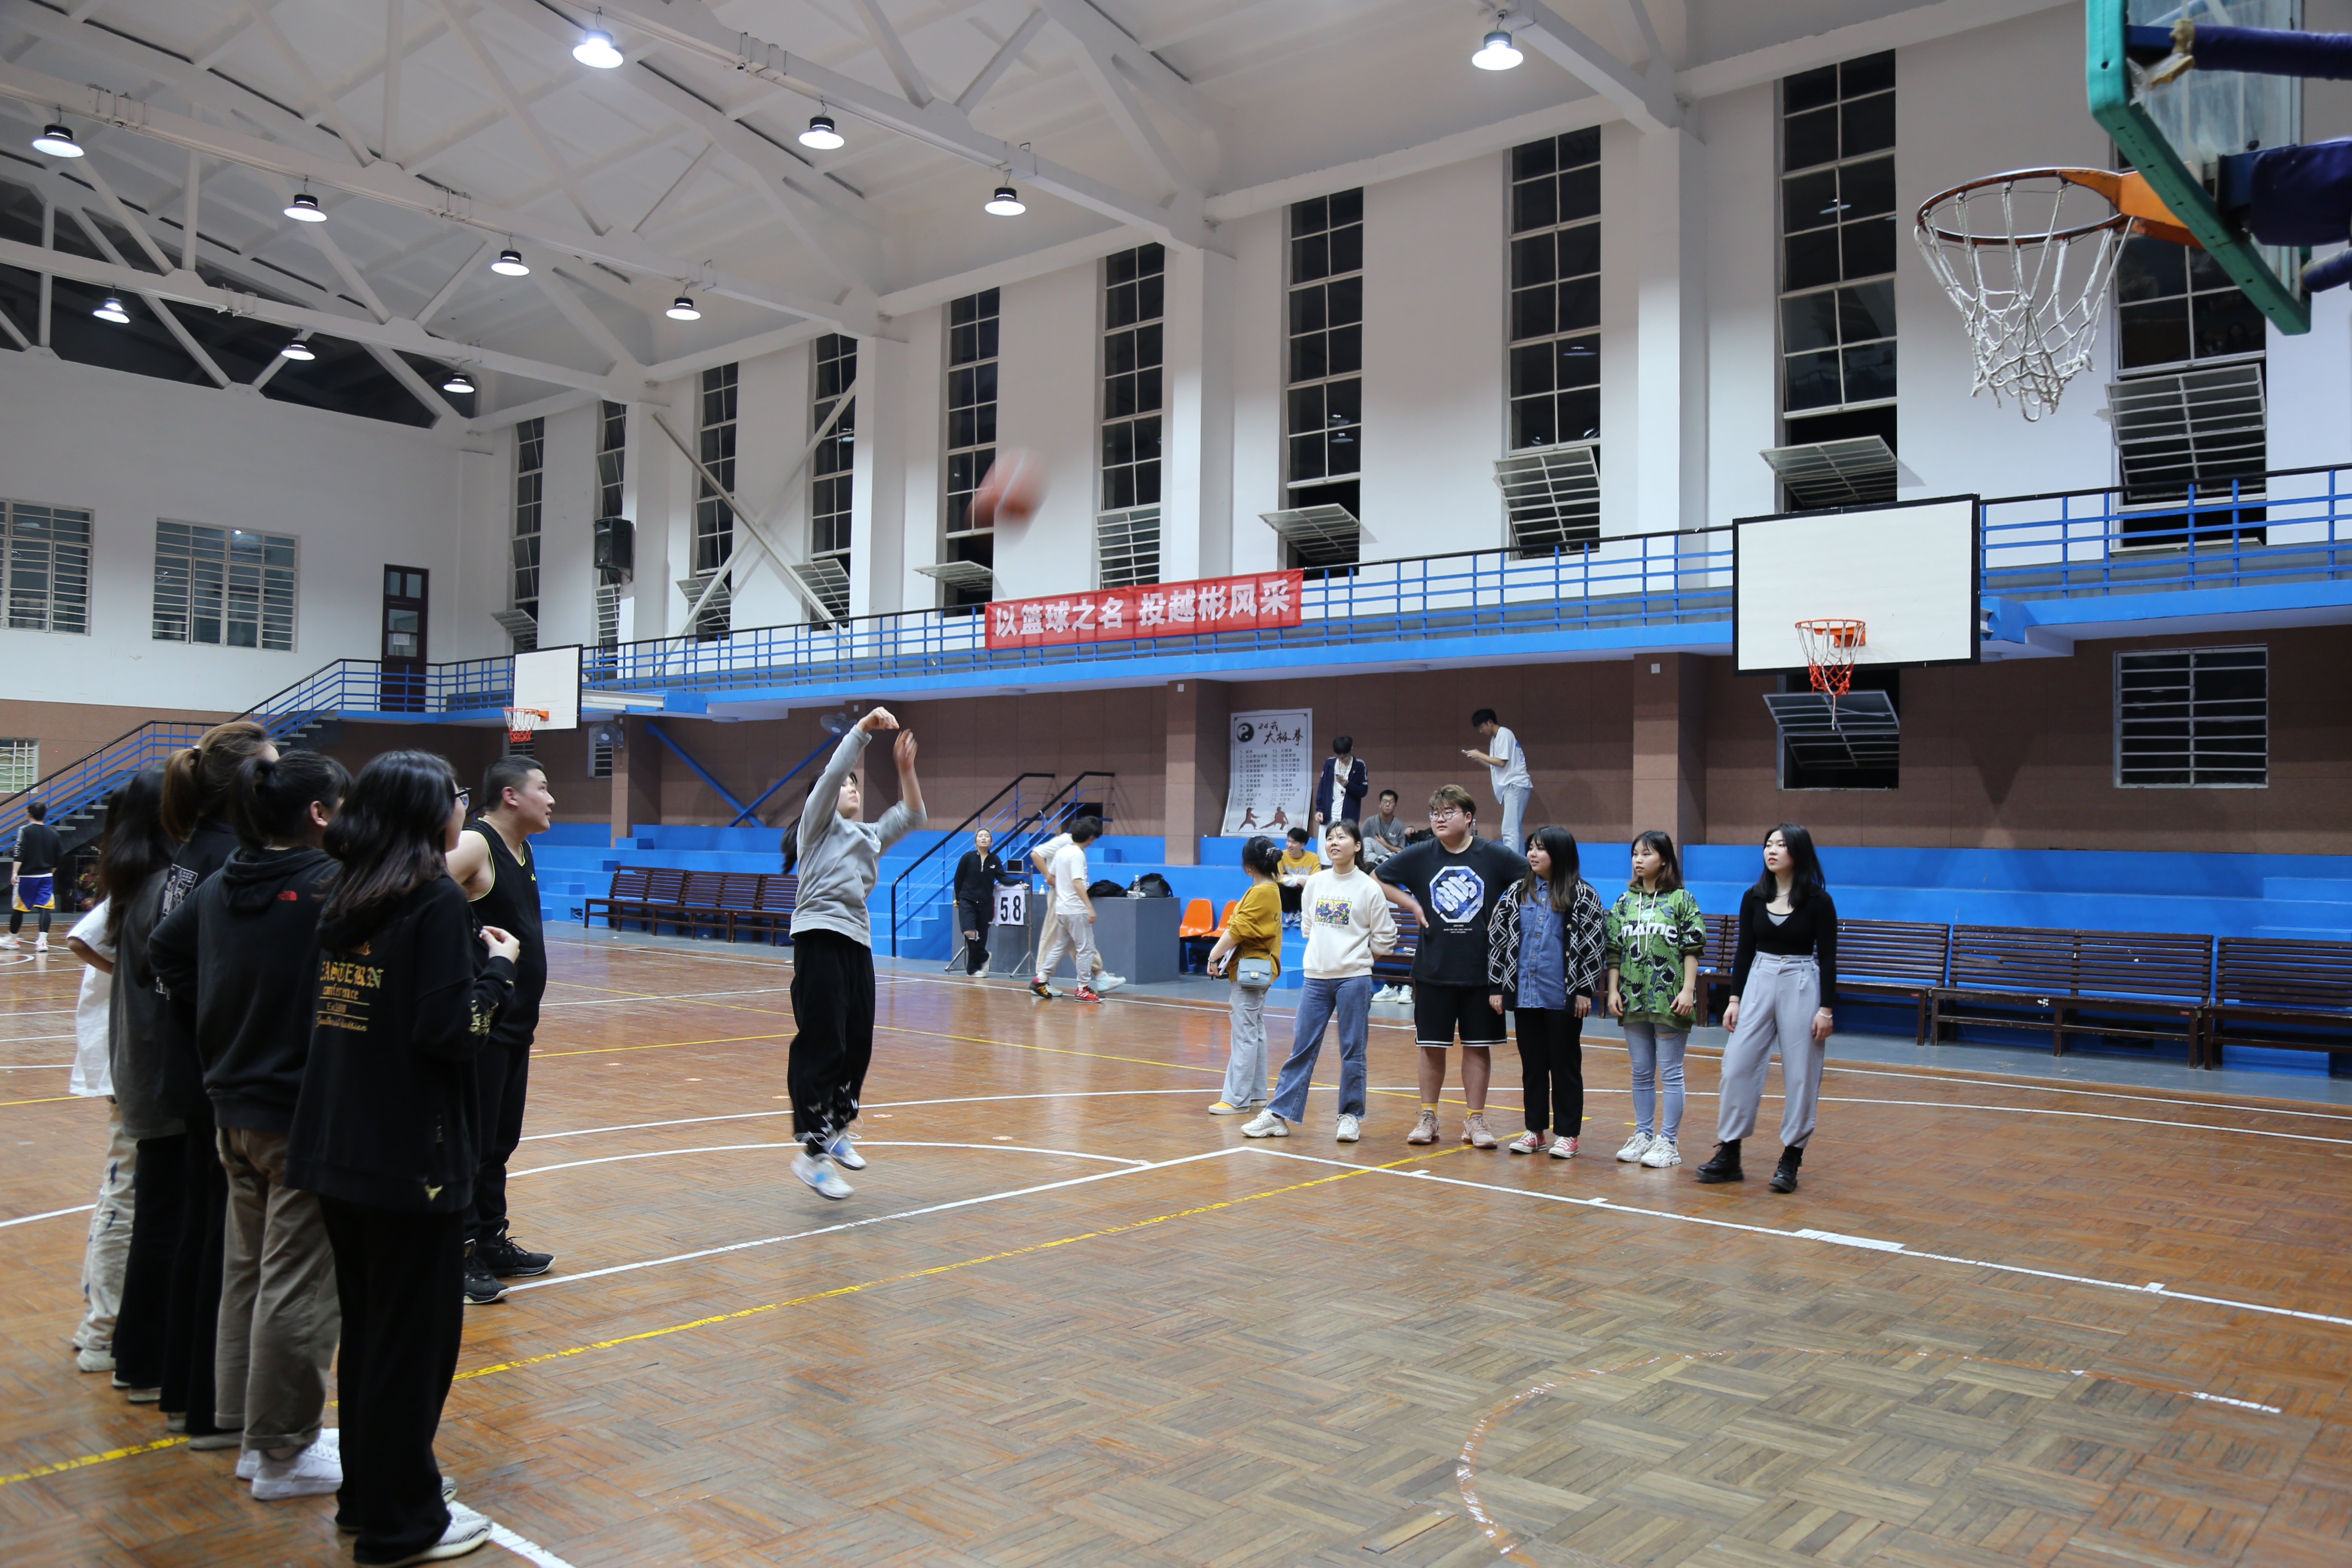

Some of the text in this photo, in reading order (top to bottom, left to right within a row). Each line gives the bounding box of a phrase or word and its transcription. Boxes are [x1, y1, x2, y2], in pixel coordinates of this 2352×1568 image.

[995, 579, 1291, 638] 以篮球之名 投越彬风采
[1264, 727, 1304, 746] 太极拳
[1000, 895, 1021, 922] 58
